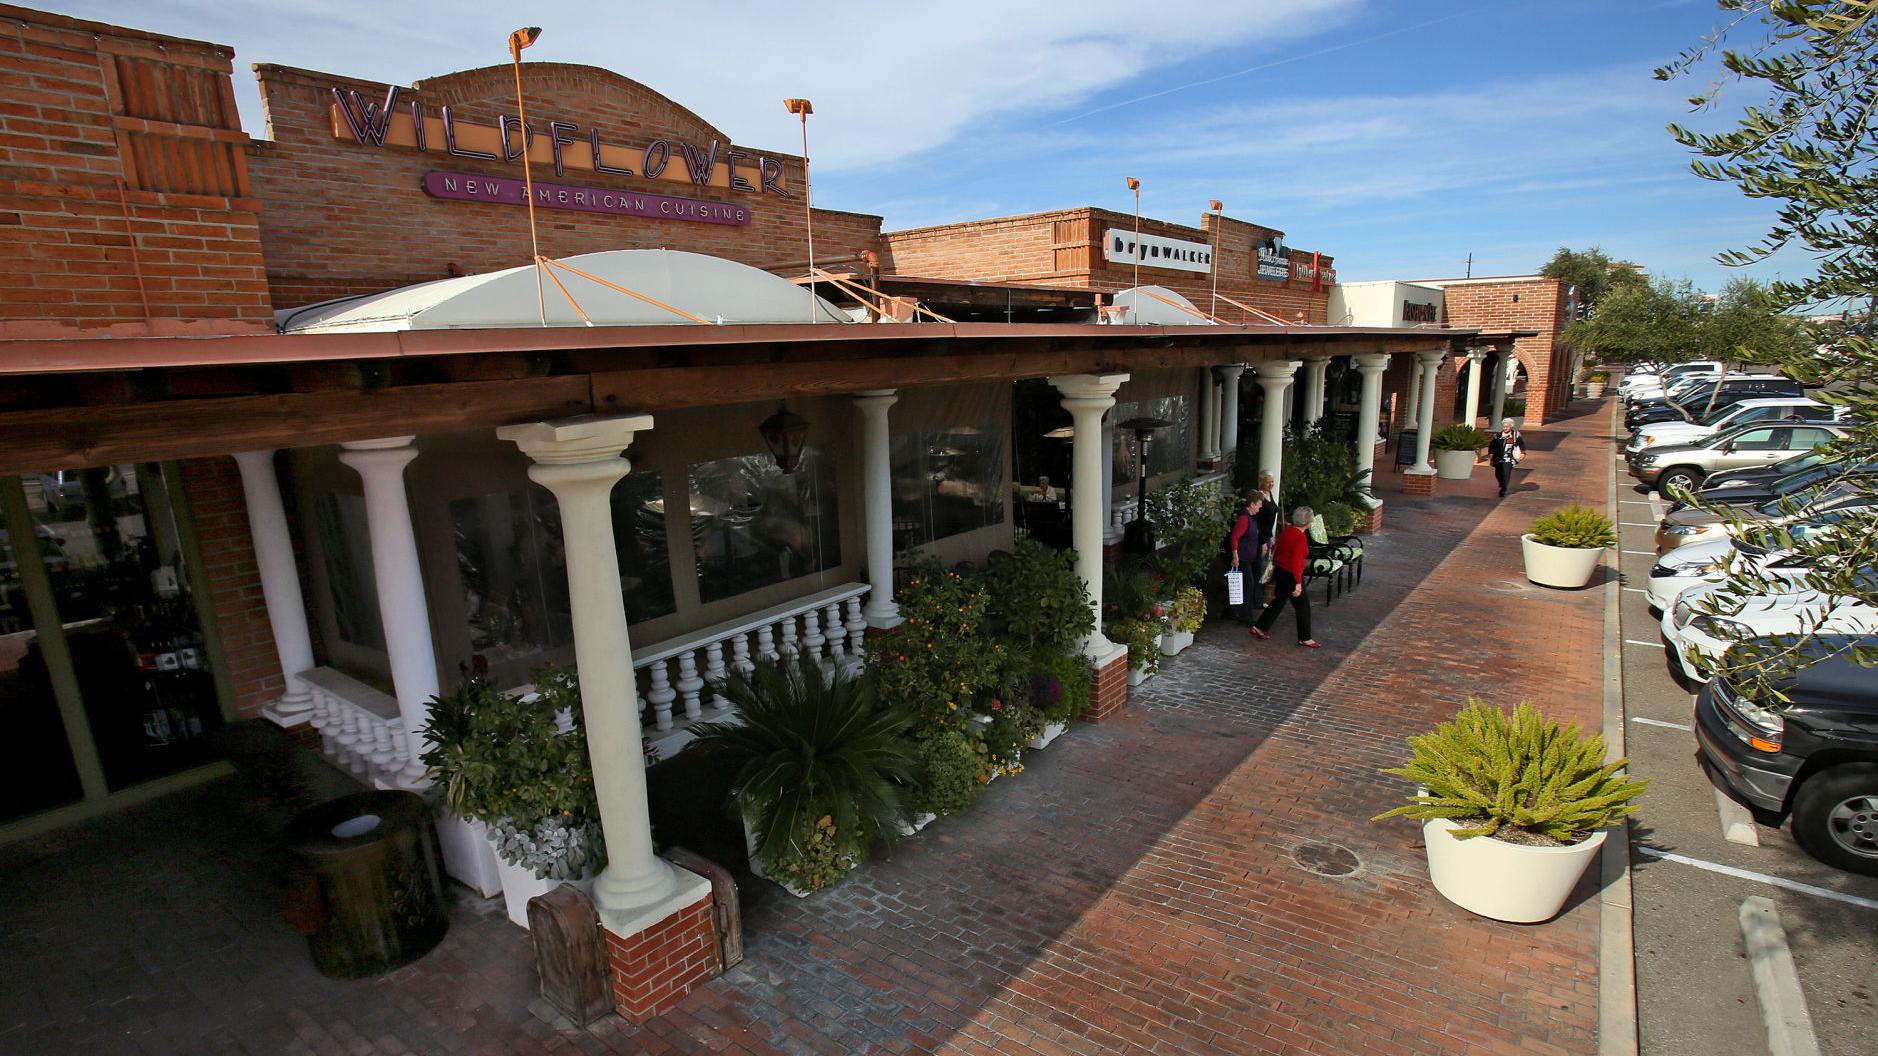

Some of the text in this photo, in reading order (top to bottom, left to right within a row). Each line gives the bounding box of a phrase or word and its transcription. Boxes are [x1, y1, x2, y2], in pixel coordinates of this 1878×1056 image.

[332, 86, 791, 197] WILDFLOWER
[444, 177, 745, 222] NEW AMERICAN CUISINE
